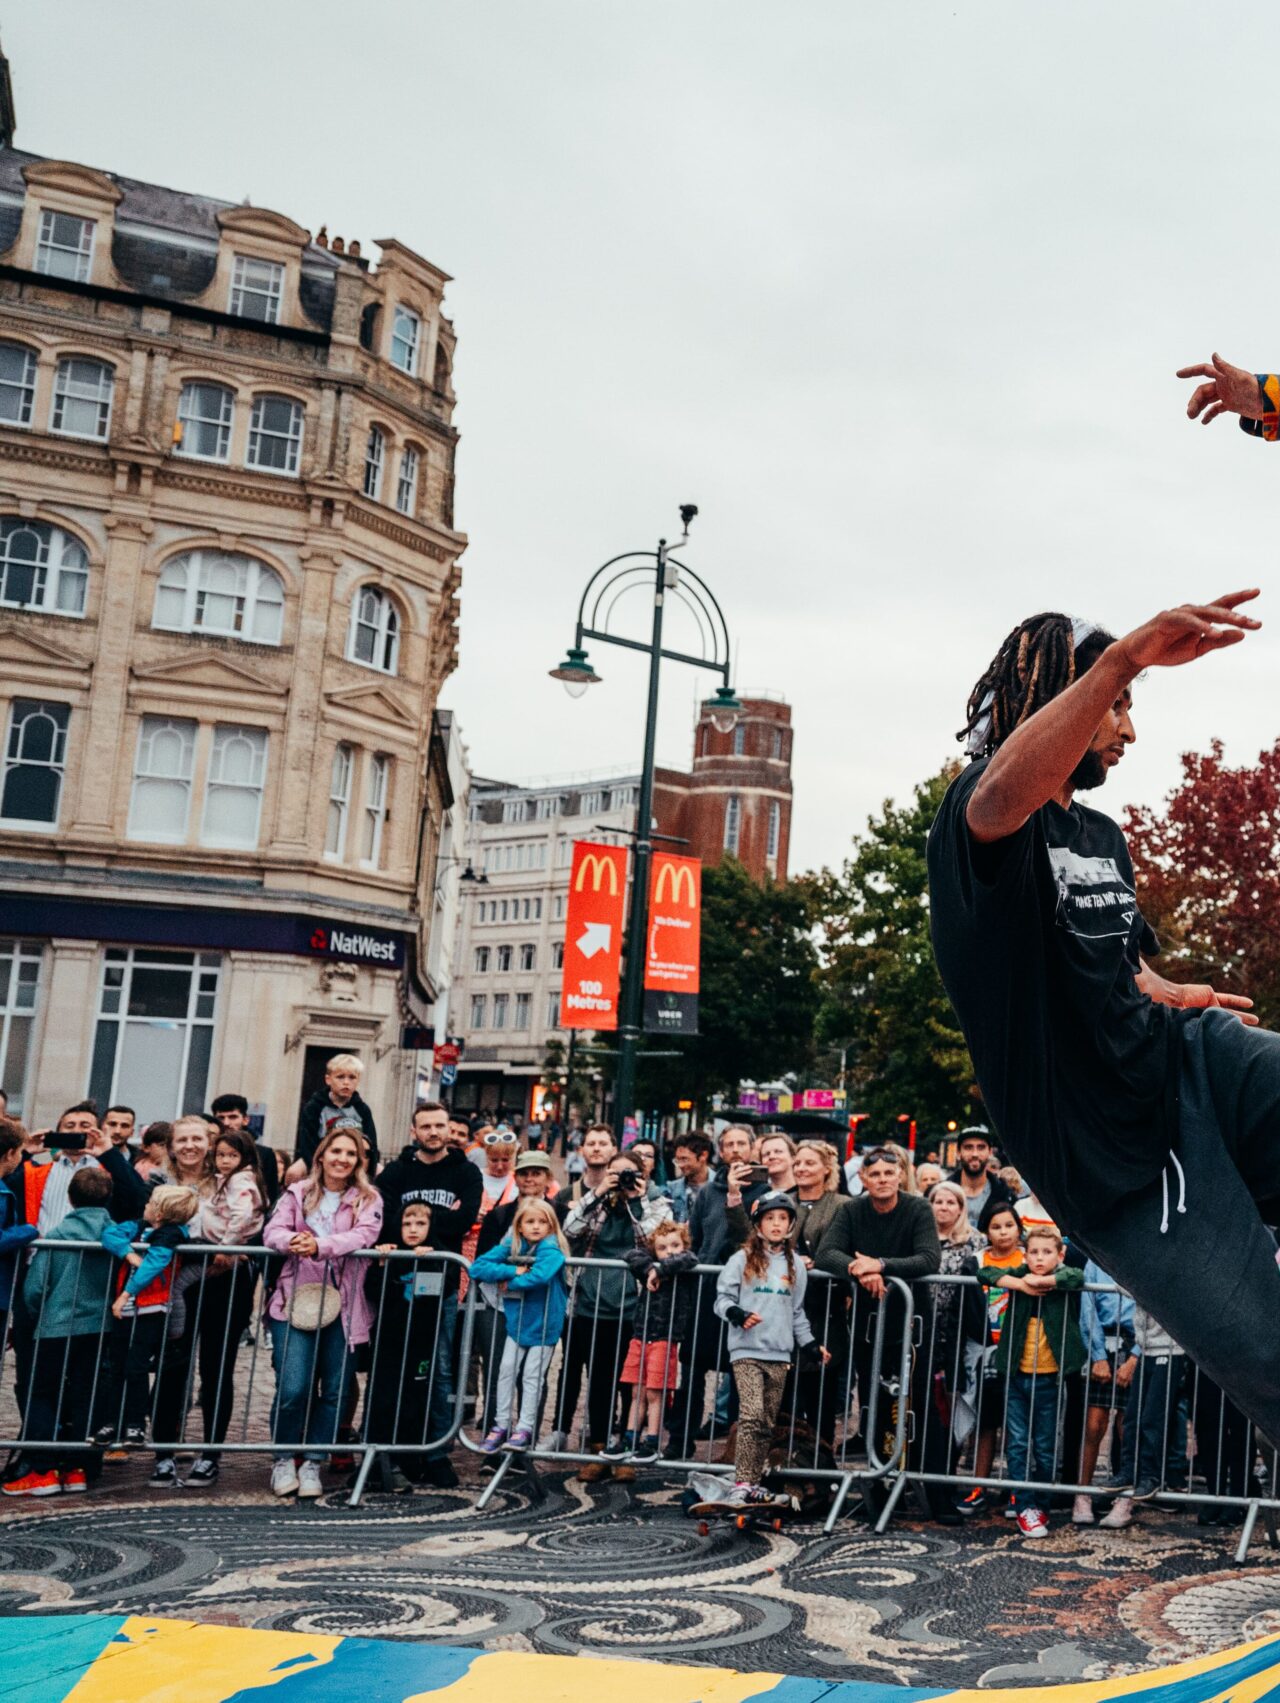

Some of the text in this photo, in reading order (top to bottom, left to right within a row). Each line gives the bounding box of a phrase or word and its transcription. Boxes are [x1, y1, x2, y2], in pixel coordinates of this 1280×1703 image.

[330, 930, 397, 961] NatWest
[579, 980, 603, 996] 100
[567, 994, 612, 1011] Metres
[658, 1010, 683, 1019] UBER
